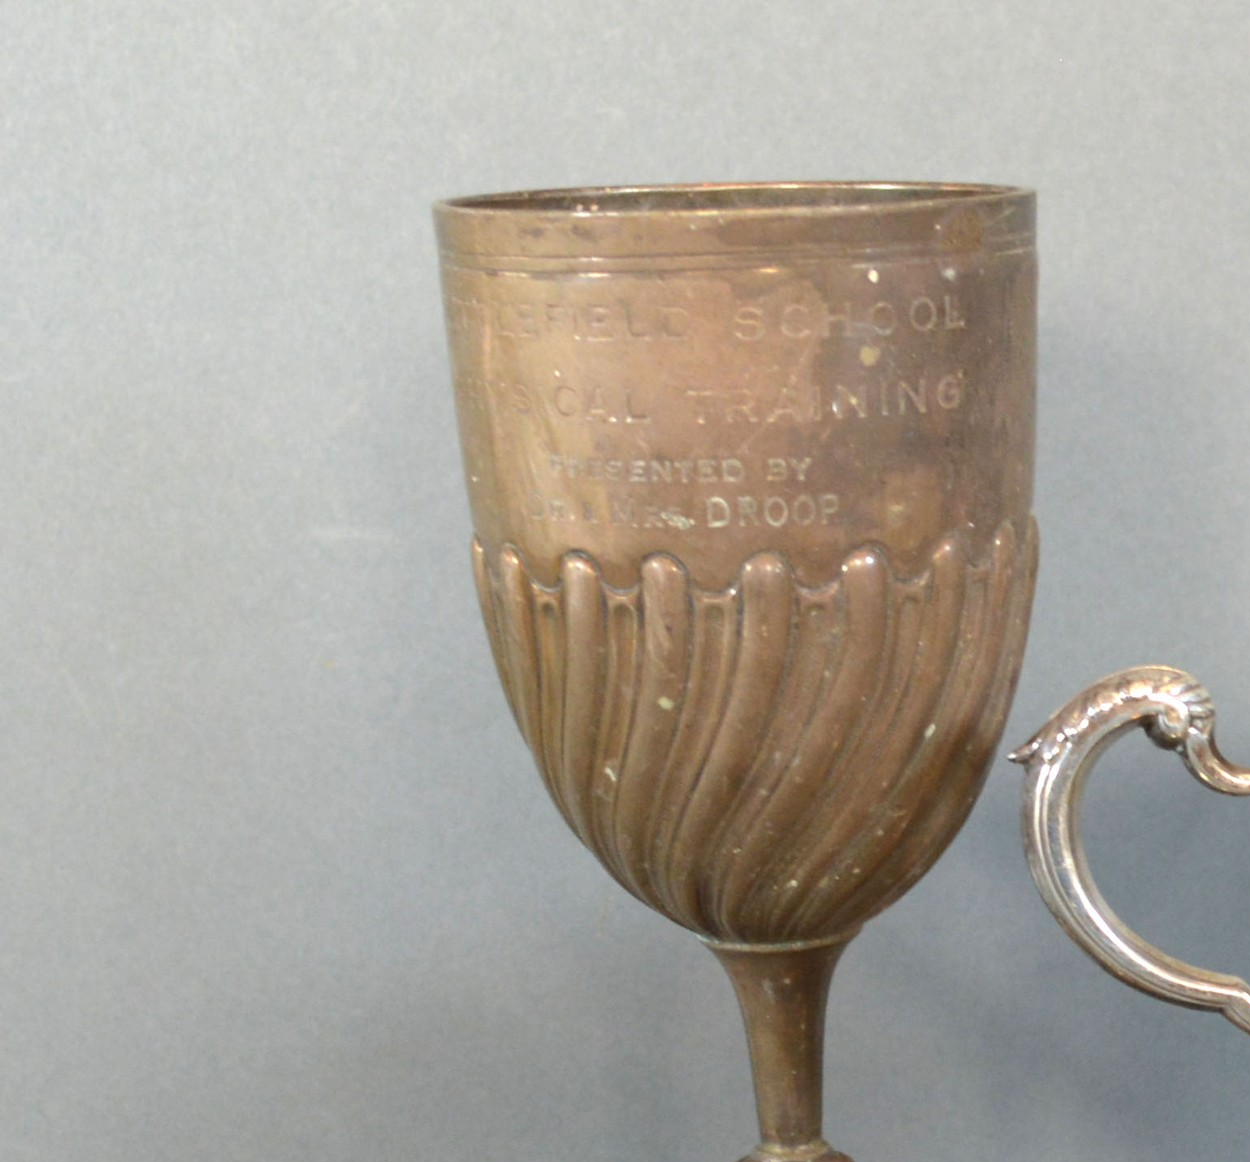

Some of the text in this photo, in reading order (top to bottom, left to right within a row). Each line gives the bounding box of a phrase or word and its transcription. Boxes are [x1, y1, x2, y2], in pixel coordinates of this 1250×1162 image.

[733, 294, 966, 342] SCHOOL
[686, 375, 964, 425] TRAINING
[765, 456, 813, 482] BY
[704, 494, 840, 529] DROOP
